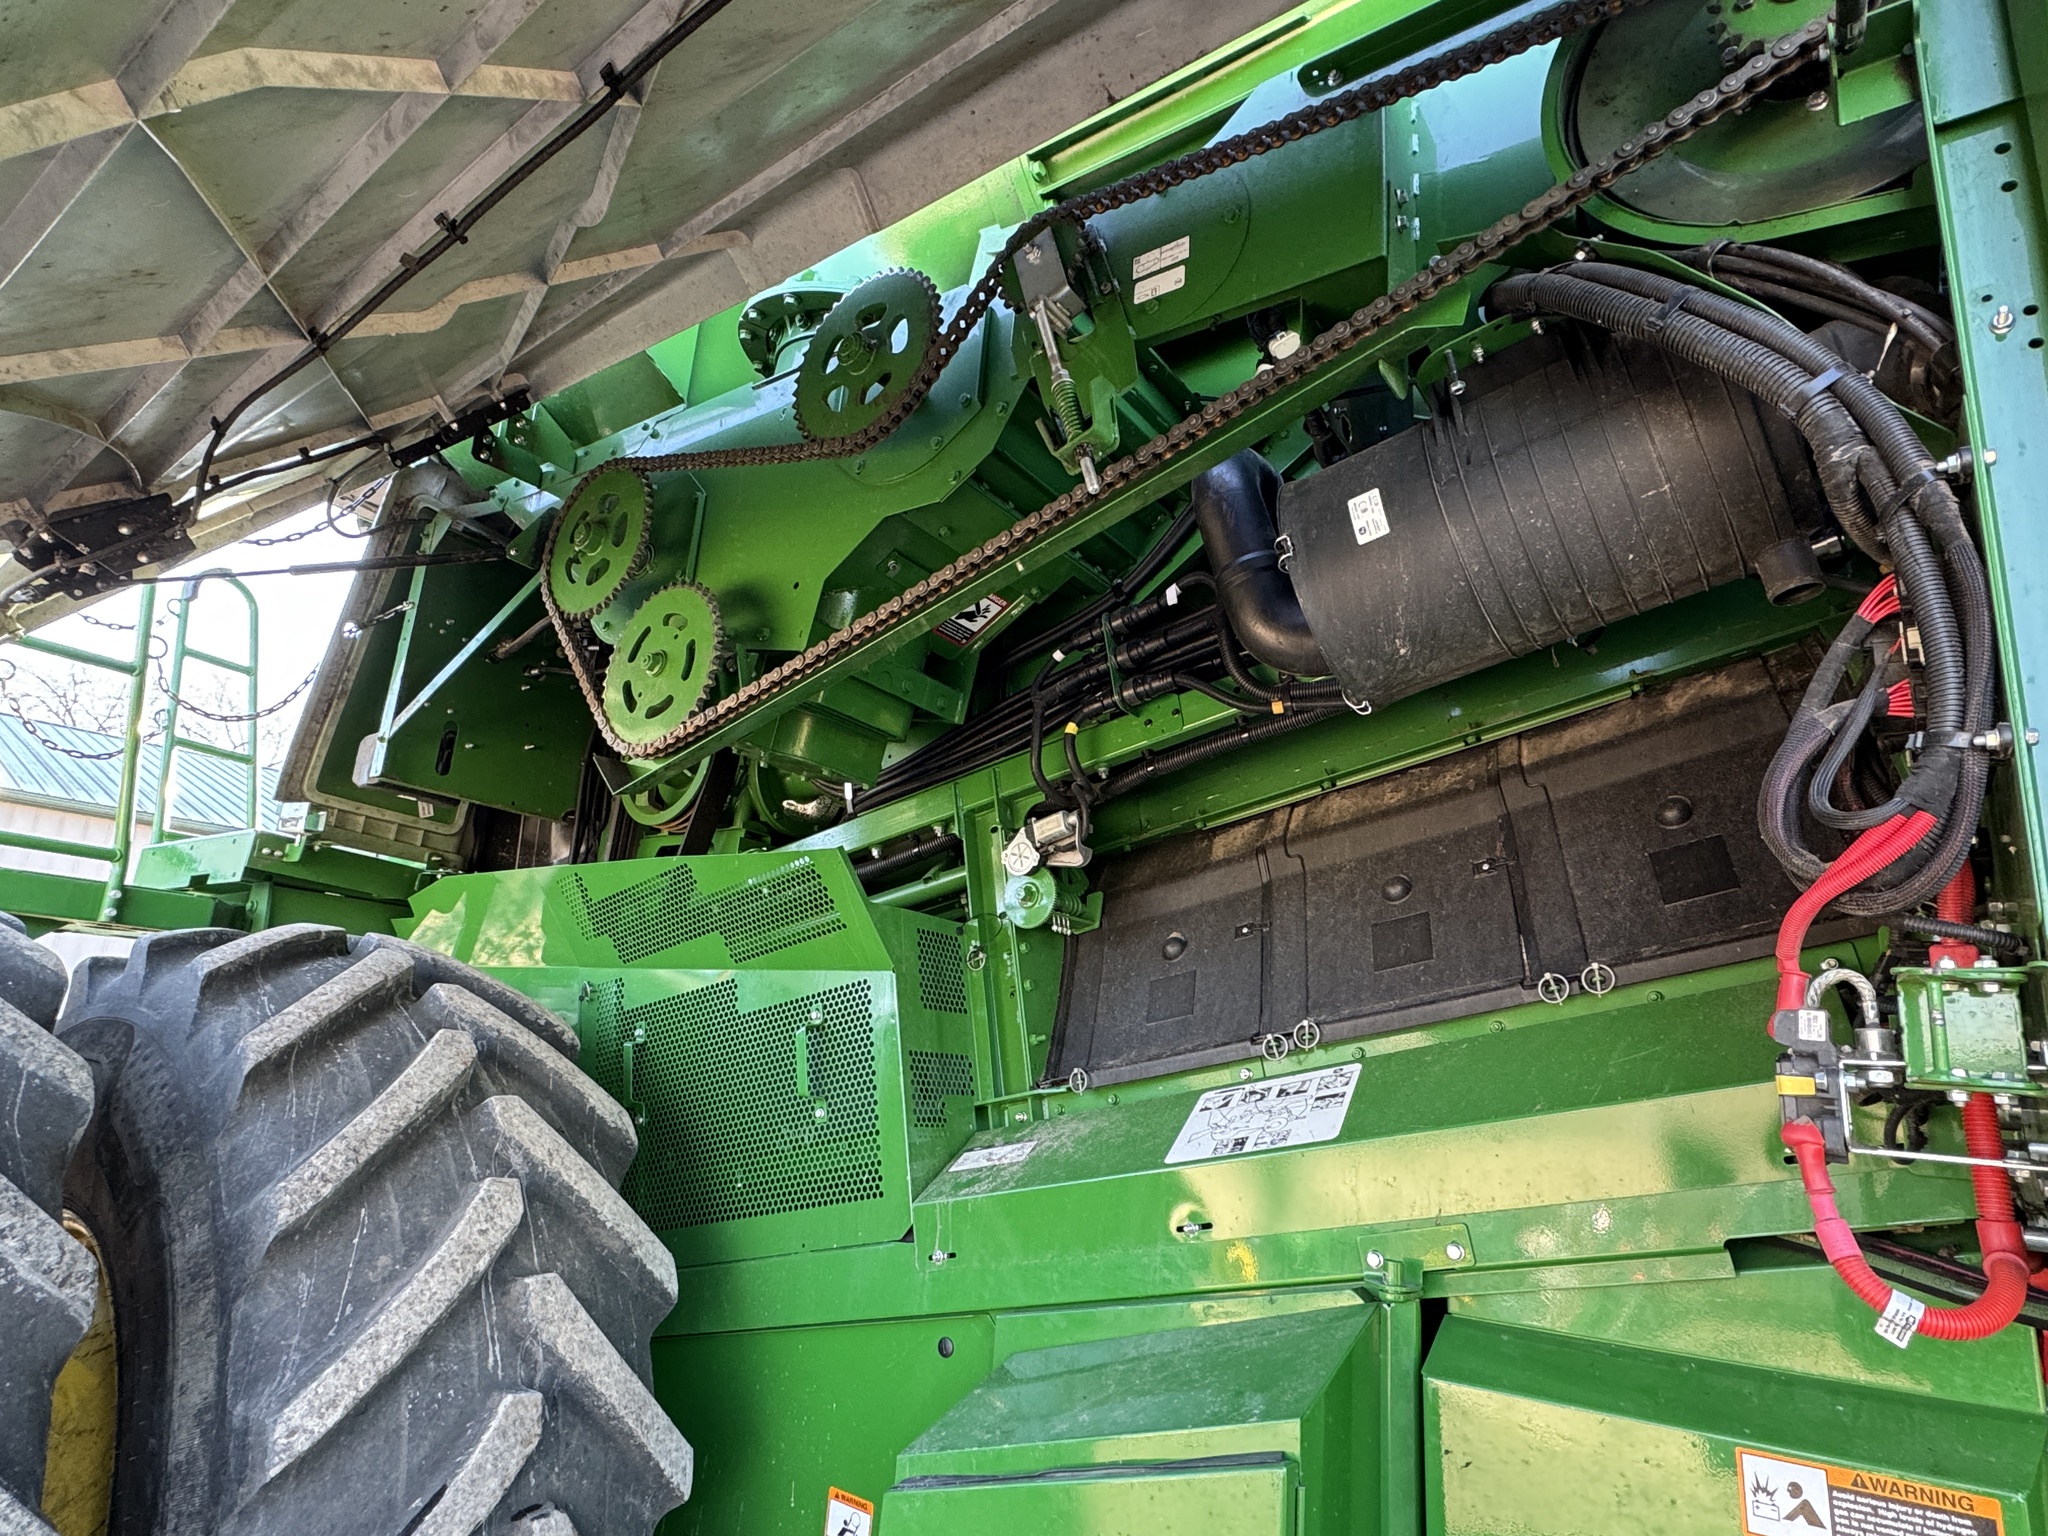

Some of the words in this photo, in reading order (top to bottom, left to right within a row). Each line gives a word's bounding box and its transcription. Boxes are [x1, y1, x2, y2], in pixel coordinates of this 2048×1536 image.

[841, 1493, 868, 1511] WARNING
[1832, 1490, 1855, 1501] Avoid
[1856, 1496, 1887, 1508] serious
[1888, 1502, 1912, 1514] injury
[1925, 1510, 1950, 1522] death
[1951, 1515, 1973, 1527] from
[1869, 1476, 1974, 1512] WARNING
